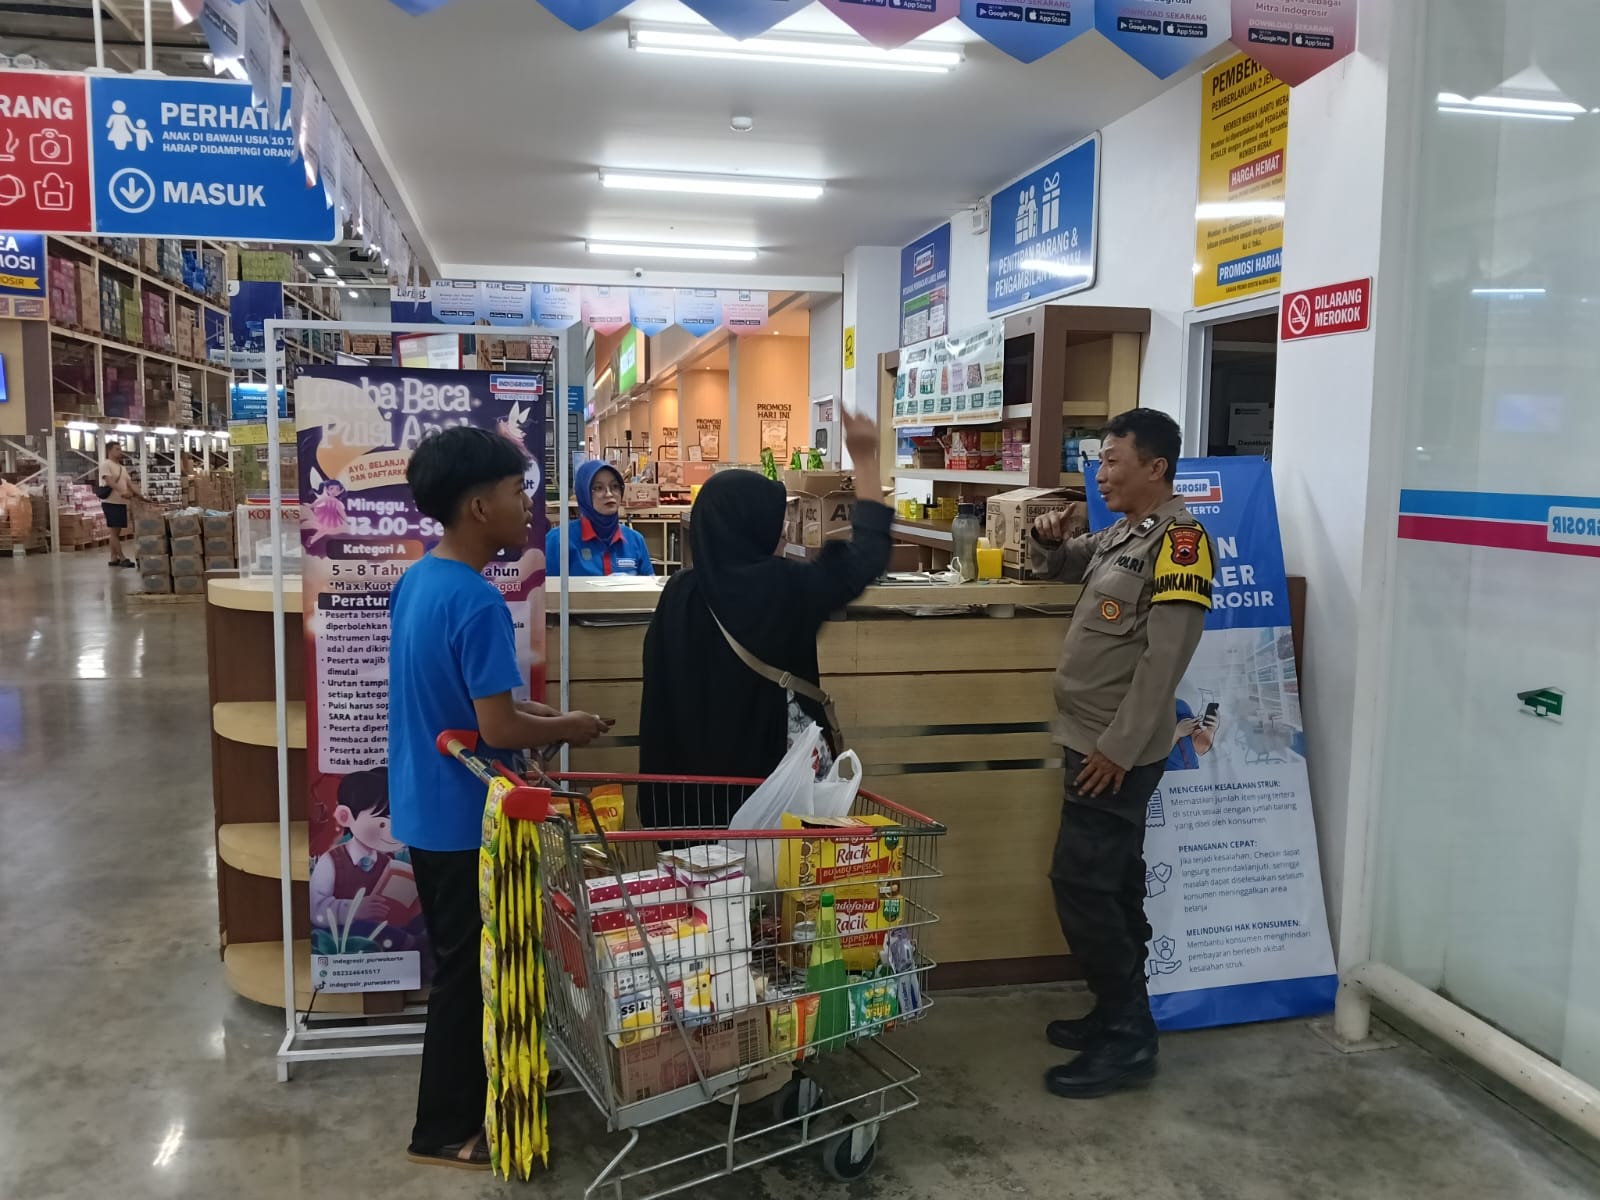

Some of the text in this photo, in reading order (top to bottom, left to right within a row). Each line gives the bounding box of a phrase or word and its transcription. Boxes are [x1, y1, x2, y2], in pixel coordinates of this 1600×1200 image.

[988, 9, 1020, 19] Google Play
[1165, 12, 1208, 21] SEKARANG
[1255, 3, 1328, 17] Mitra Indogrosir
[1128, 23, 1159, 32] Google Play
[1259, 34, 1288, 43] Google Play
[1211, 84, 1257, 113] PEMBERLAKUAN
[162, 131, 285, 145] ANAK DI BAWAH USIA 10
[162, 143, 197, 153] HARAP
[200, 145, 261, 156] DIDAMPINGI
[1231, 154, 1280, 186] HARGA HEMAT
[163, 181, 266, 207] MASUK
[1070, 227, 1079, 248] &
[0, 253, 36, 271] OSI
[1219, 257, 1254, 281] PROMOSI
[994, 270, 1048, 299] PENGAMBILAN
[1314, 288, 1362, 310] DILARANG
[1314, 306, 1360, 327] MEROKOK
[400, 377, 473, 414] Baca
[756, 403, 792, 412] PROMOSI
[320, 411, 396, 449] Puisi
[368, 458, 406, 470] BELANJA
[350, 473, 367, 482] DAN
[343, 543, 406, 557] Kategori A
[1216, 536, 1239, 560] N
[332, 564, 340, 576] 5
[357, 564, 366, 576] 8
[1113, 555, 1145, 574] POLRI
[325, 611, 358, 619] Peserta
[325, 622, 388, 632] diperbolehkan
[346, 645, 364, 653] dan
[327, 656, 386, 666] Peserta wajib
[327, 667, 359, 676] dimulai
[327, 679, 358, 687] Urutan
[327, 691, 354, 701] setiap
[328, 701, 374, 709] Puisi harus
[328, 713, 374, 721] SARA atau
[329, 724, 360, 732] Peserta
[329, 735, 369, 744] membaca
[329, 746, 385, 755] Peserta akan
[329, 757, 351, 766] tidak
[1169, 784, 1213, 795] MENCEGAH
[1214, 782, 1257, 792] KESALAHAN
[1223, 805, 1252, 816] dengan
[1174, 821, 1194, 831] yang
[1178, 839, 1258, 853] PENANGANAN CEPAT:
[836, 844, 871, 864] Racik
[1218, 886, 1269, 898] meninggalkan
[1270, 885, 1288, 894] area
[1186, 925, 1234, 937] MELINDUNGI
[1234, 922, 1250, 932] HAK
[1187, 930, 1311, 950] Membantu konsumen menghindari
[1188, 949, 1232, 963] pembayaran
